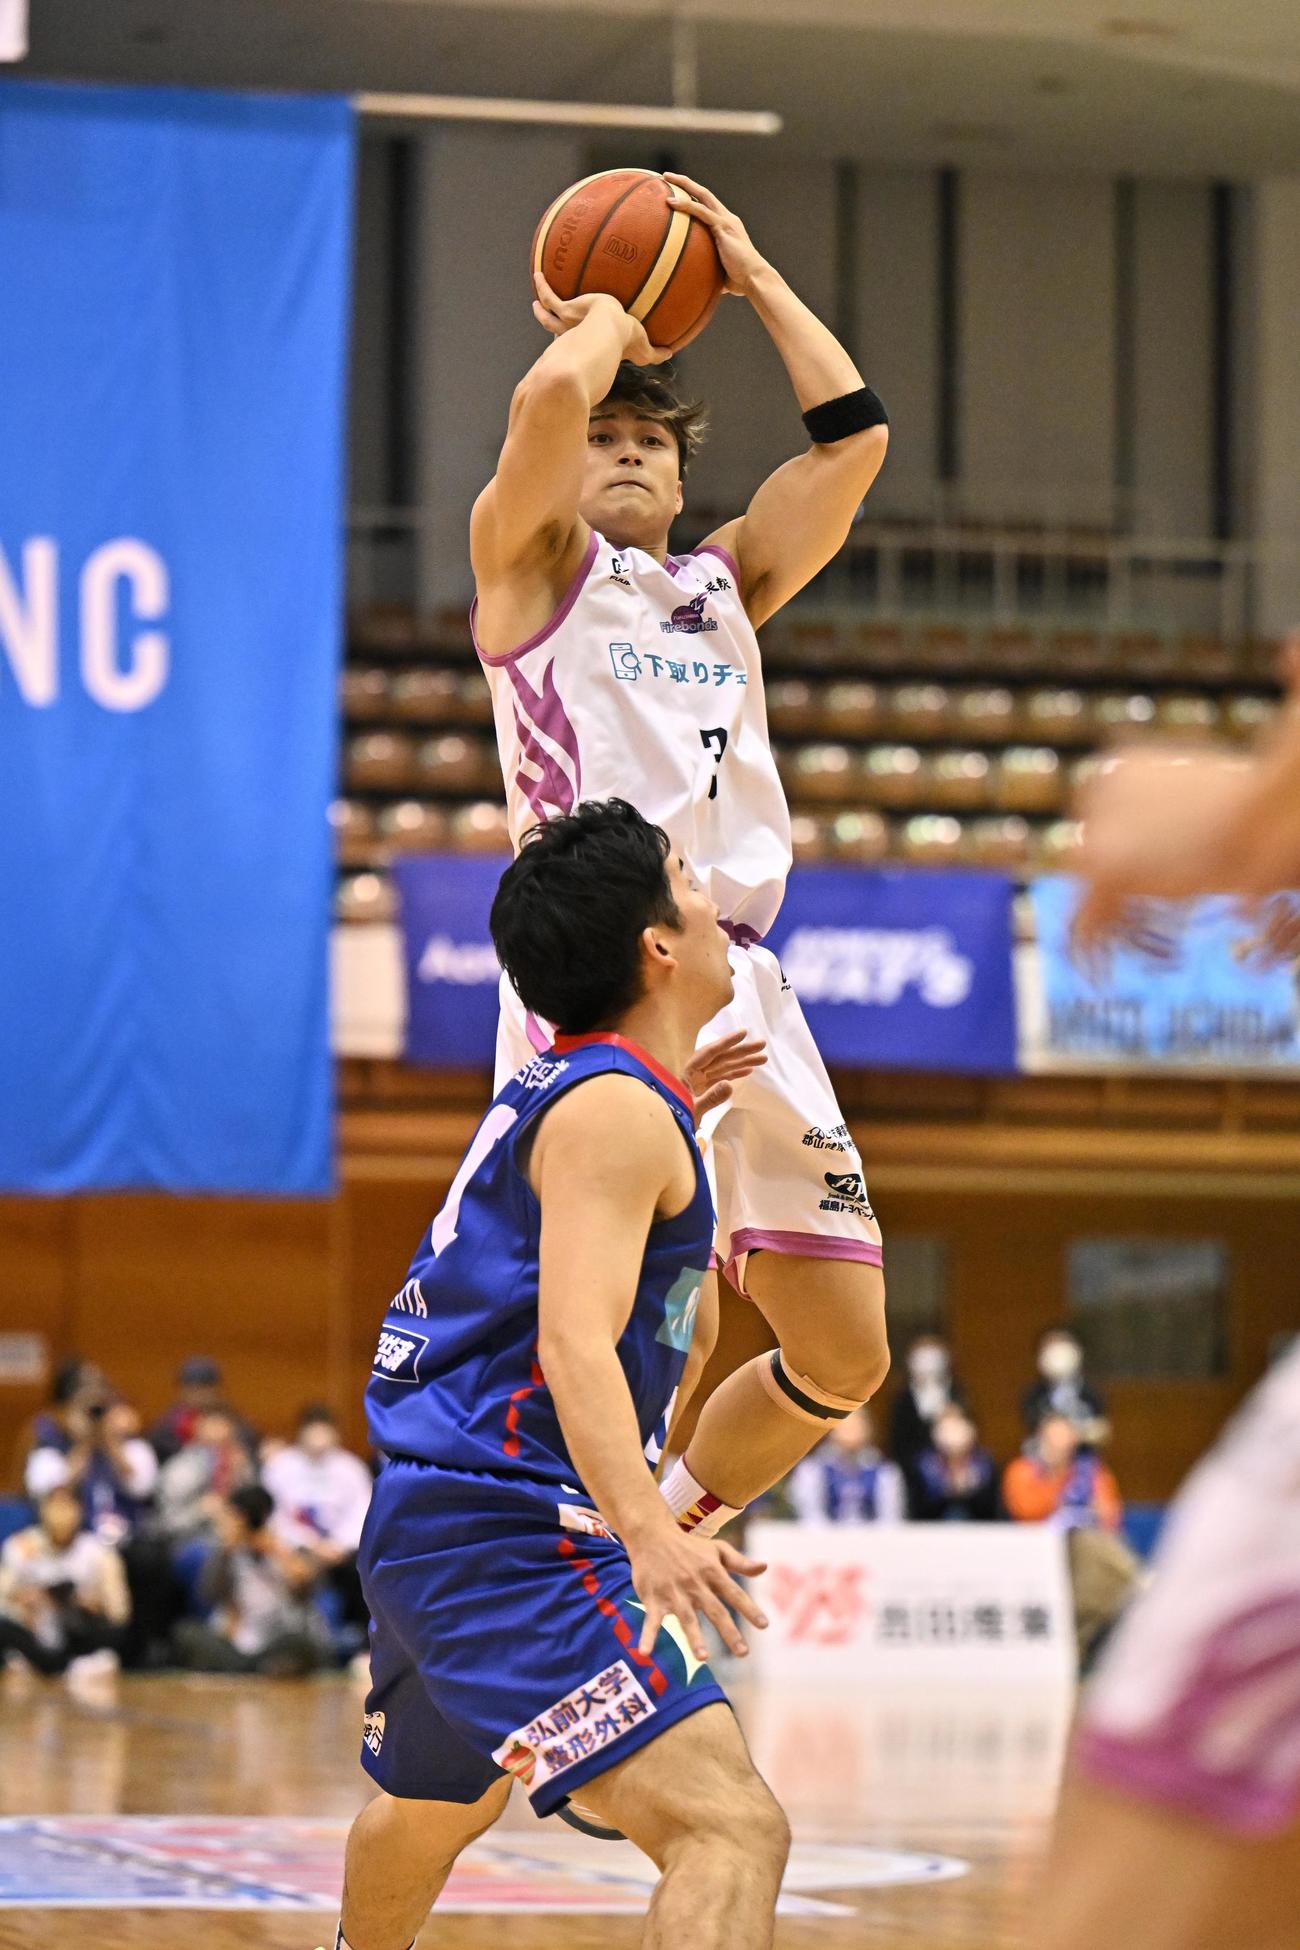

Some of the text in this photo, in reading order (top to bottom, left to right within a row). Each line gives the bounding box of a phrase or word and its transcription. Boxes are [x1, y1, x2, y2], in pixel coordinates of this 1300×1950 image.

[660, 618, 719, 633] Firebonds
[524, 1666, 629, 1748] 弘前大学
[543, 1692, 649, 1775] 整形外科
